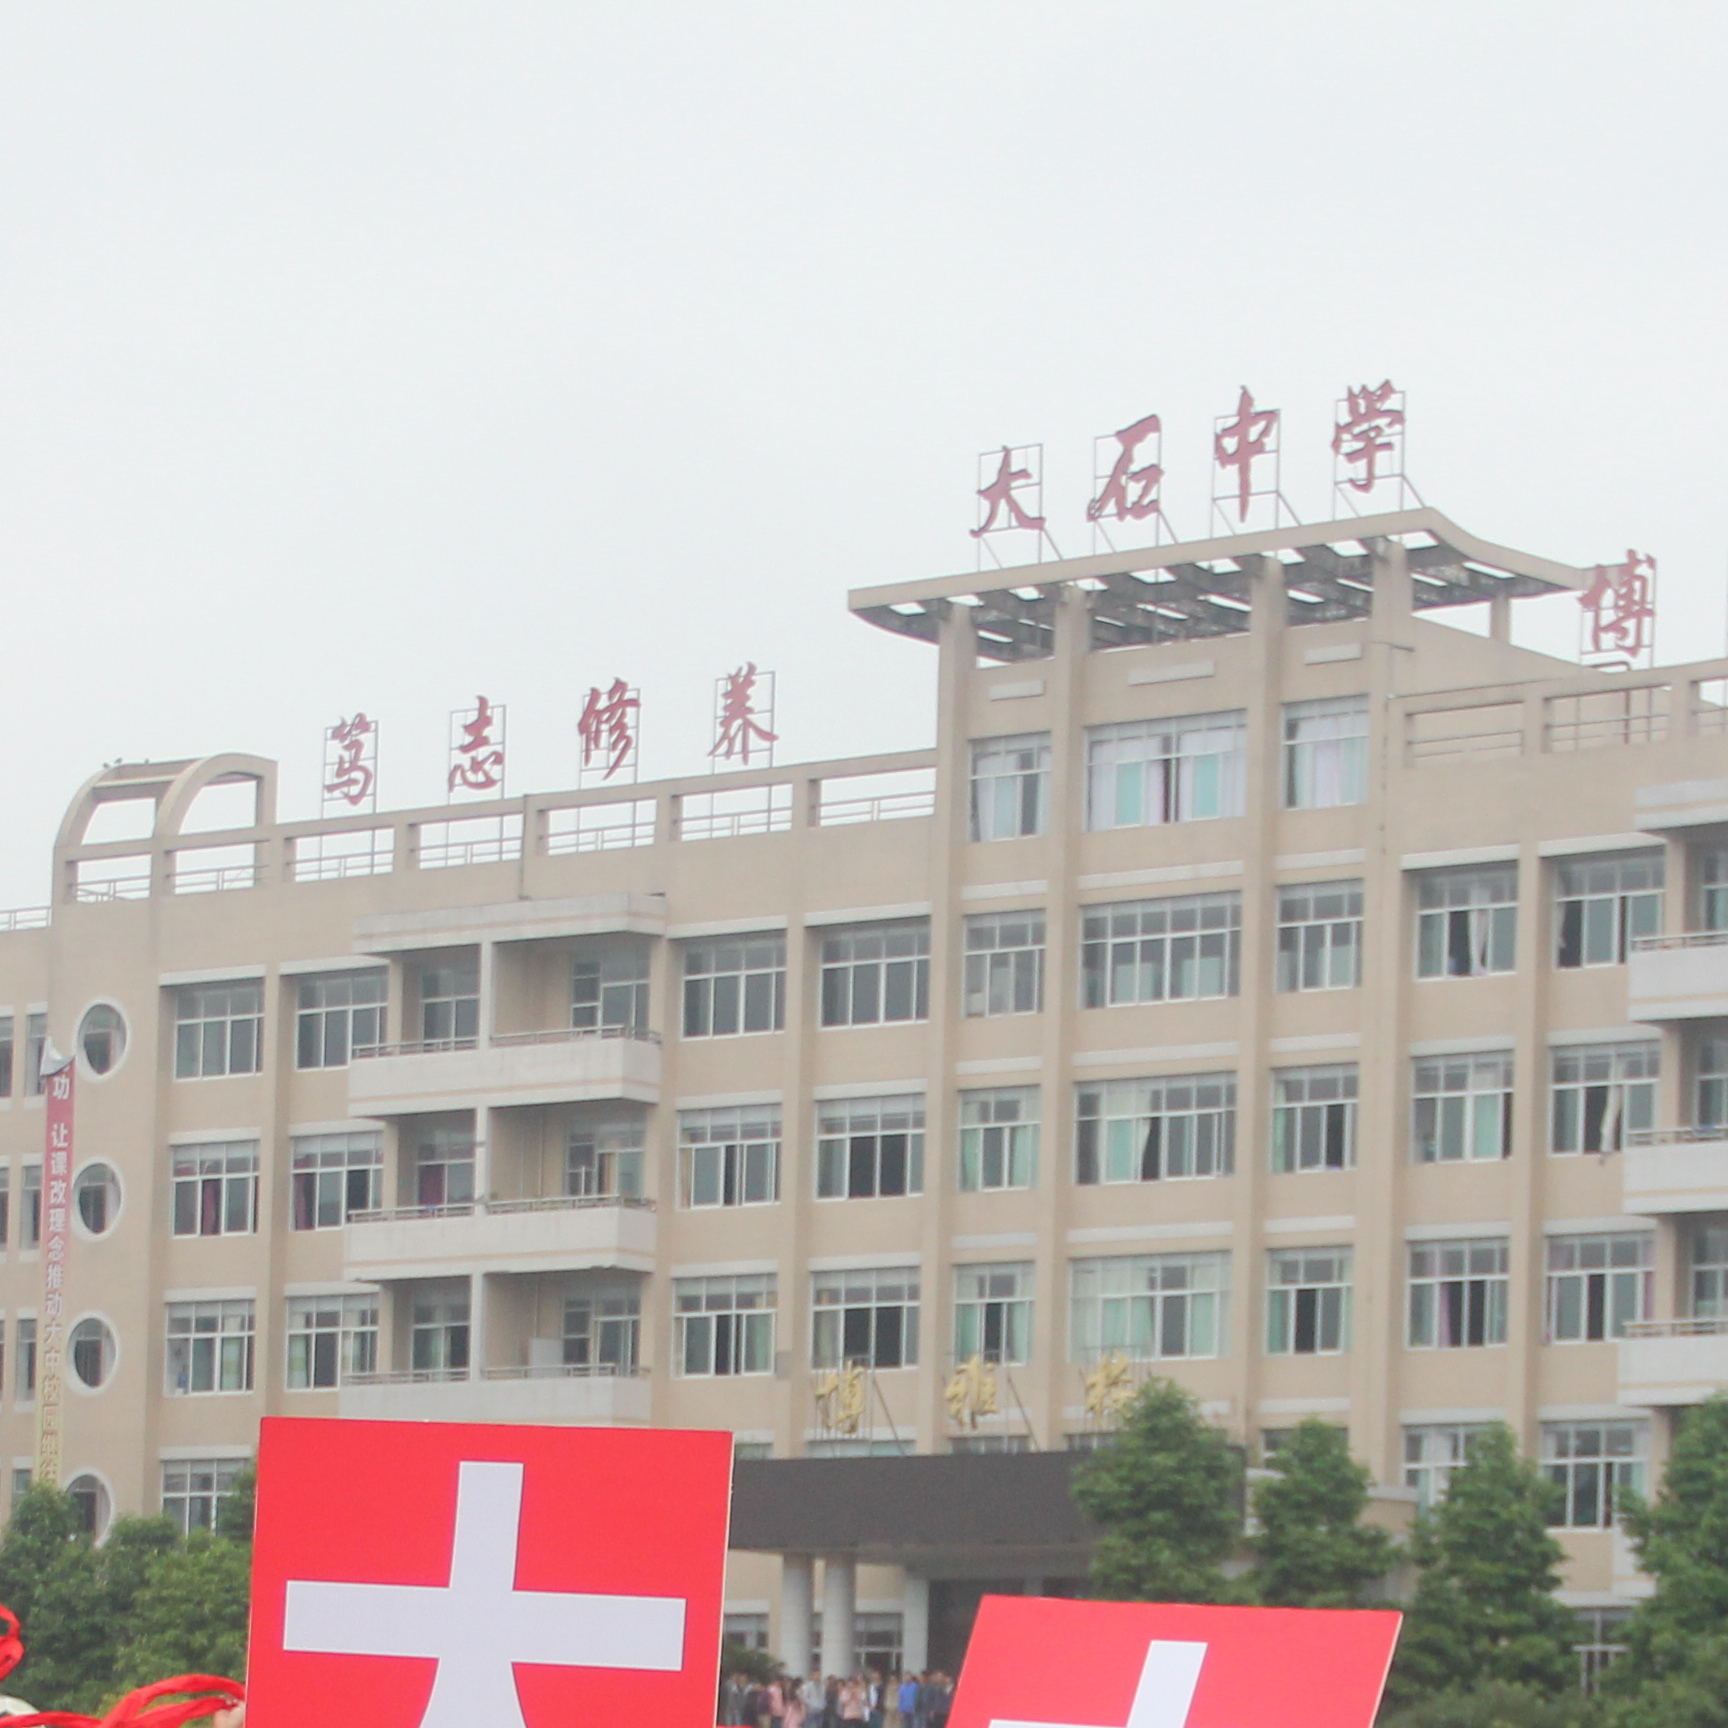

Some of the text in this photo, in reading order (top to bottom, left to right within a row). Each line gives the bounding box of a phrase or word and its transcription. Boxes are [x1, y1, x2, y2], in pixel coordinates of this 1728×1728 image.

[970, 379, 1405, 538] 大石中学
[323, 661, 779, 806] 笃志修养
